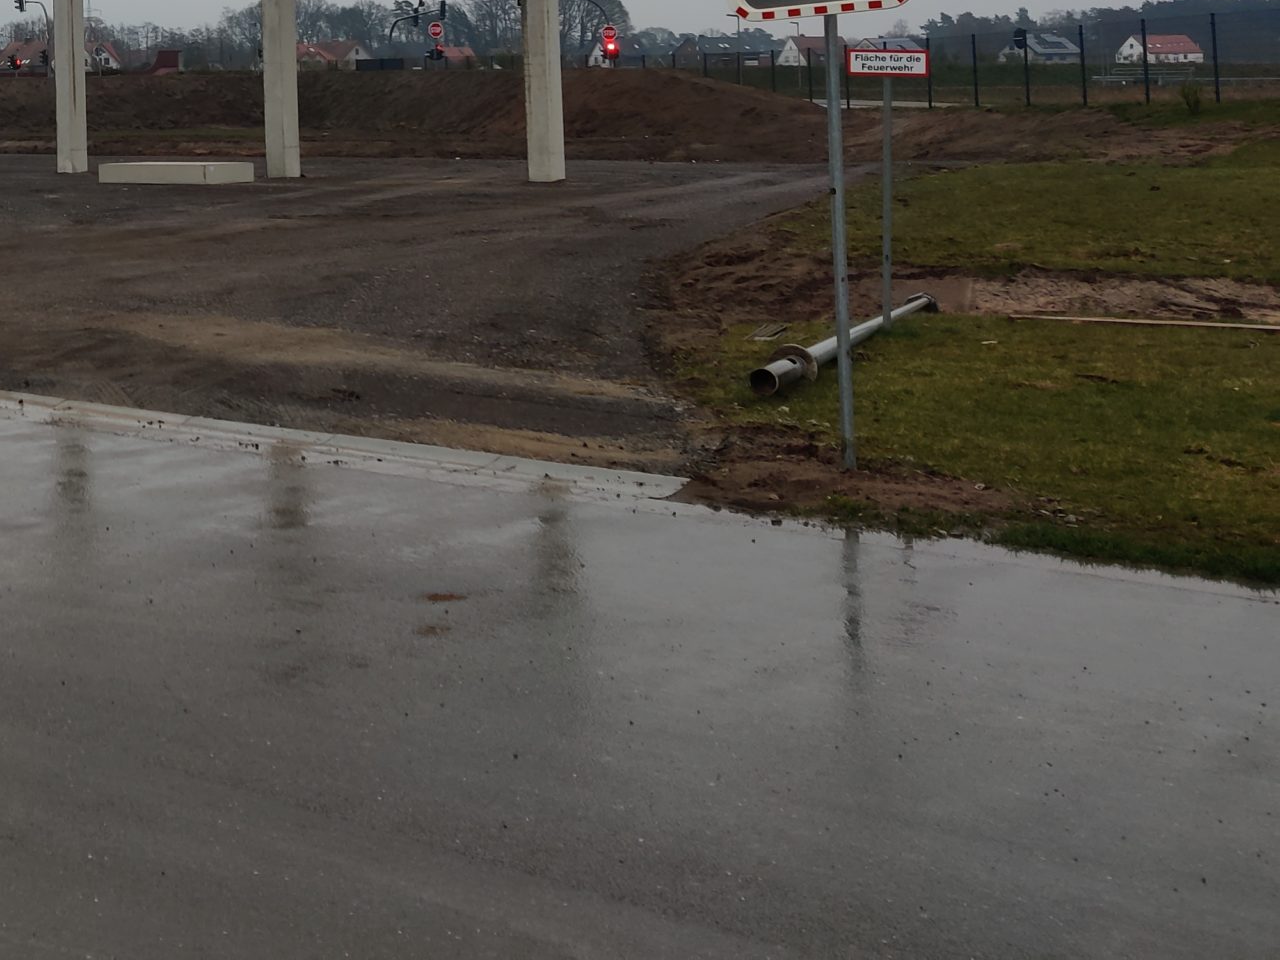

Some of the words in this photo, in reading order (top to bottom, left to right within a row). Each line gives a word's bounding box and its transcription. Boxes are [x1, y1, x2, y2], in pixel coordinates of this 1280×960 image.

[854, 53, 887, 62] Fläche
[889, 54, 904, 62] für
[906, 54, 922, 63] die
[861, 62, 914, 72] Feuerwehr
